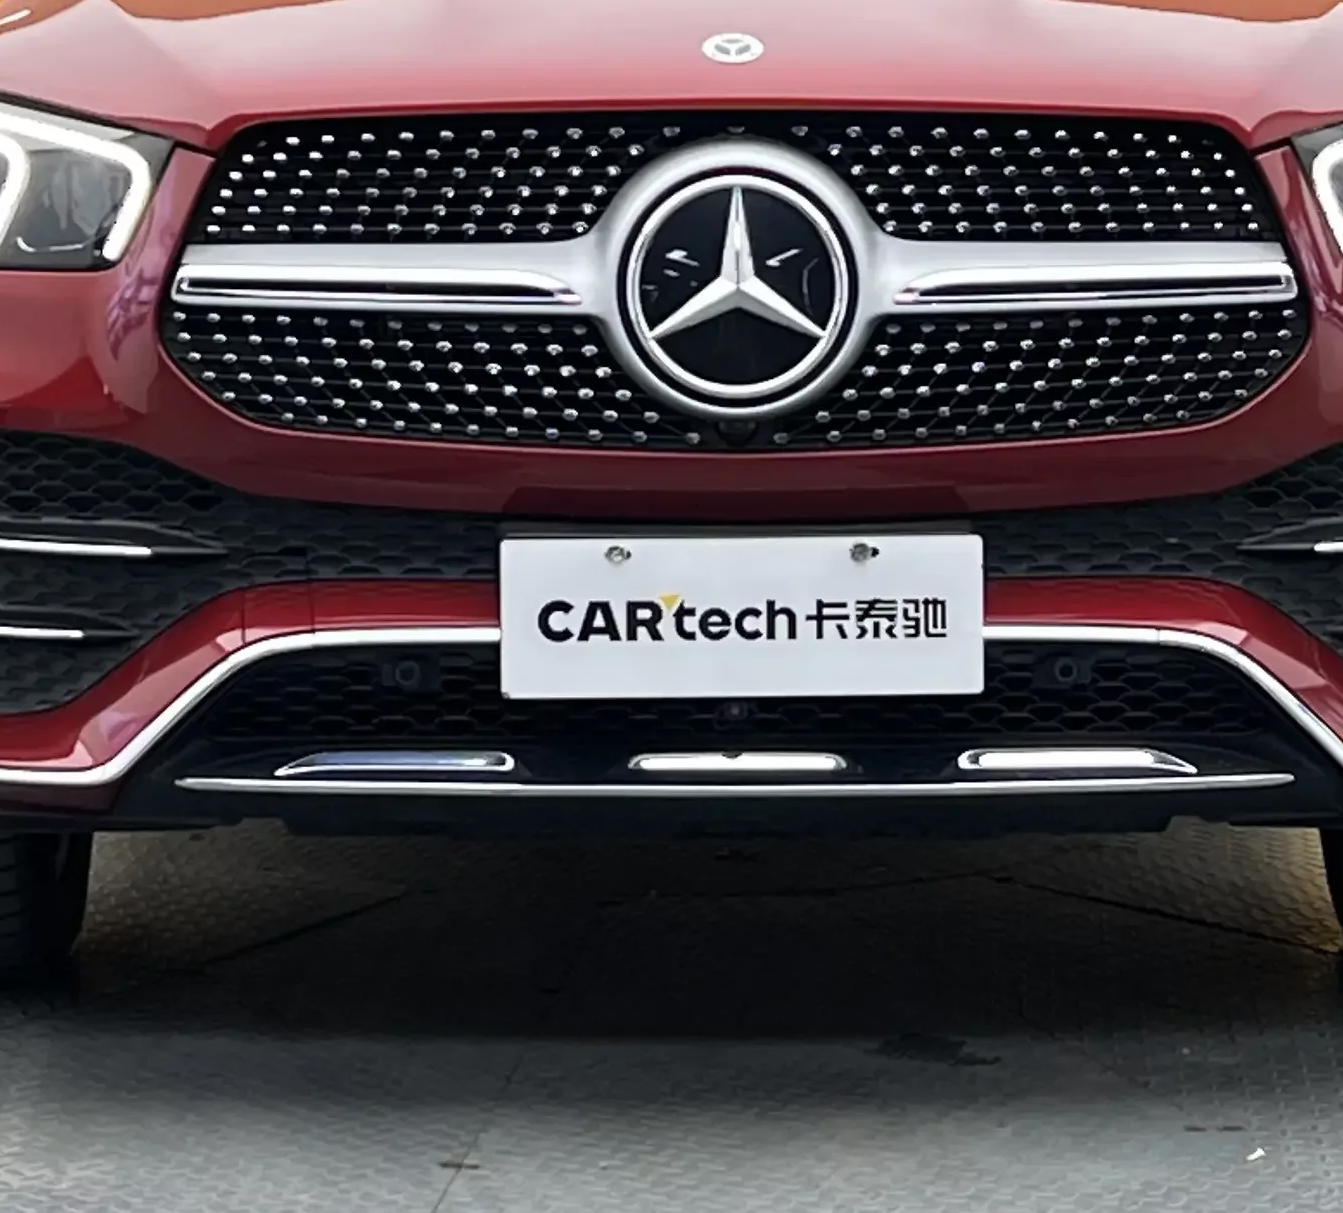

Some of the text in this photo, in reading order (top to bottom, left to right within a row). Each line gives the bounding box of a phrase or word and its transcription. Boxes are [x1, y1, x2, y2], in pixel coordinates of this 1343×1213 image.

[537, 597, 948, 643] CARtech 卡泰驰
